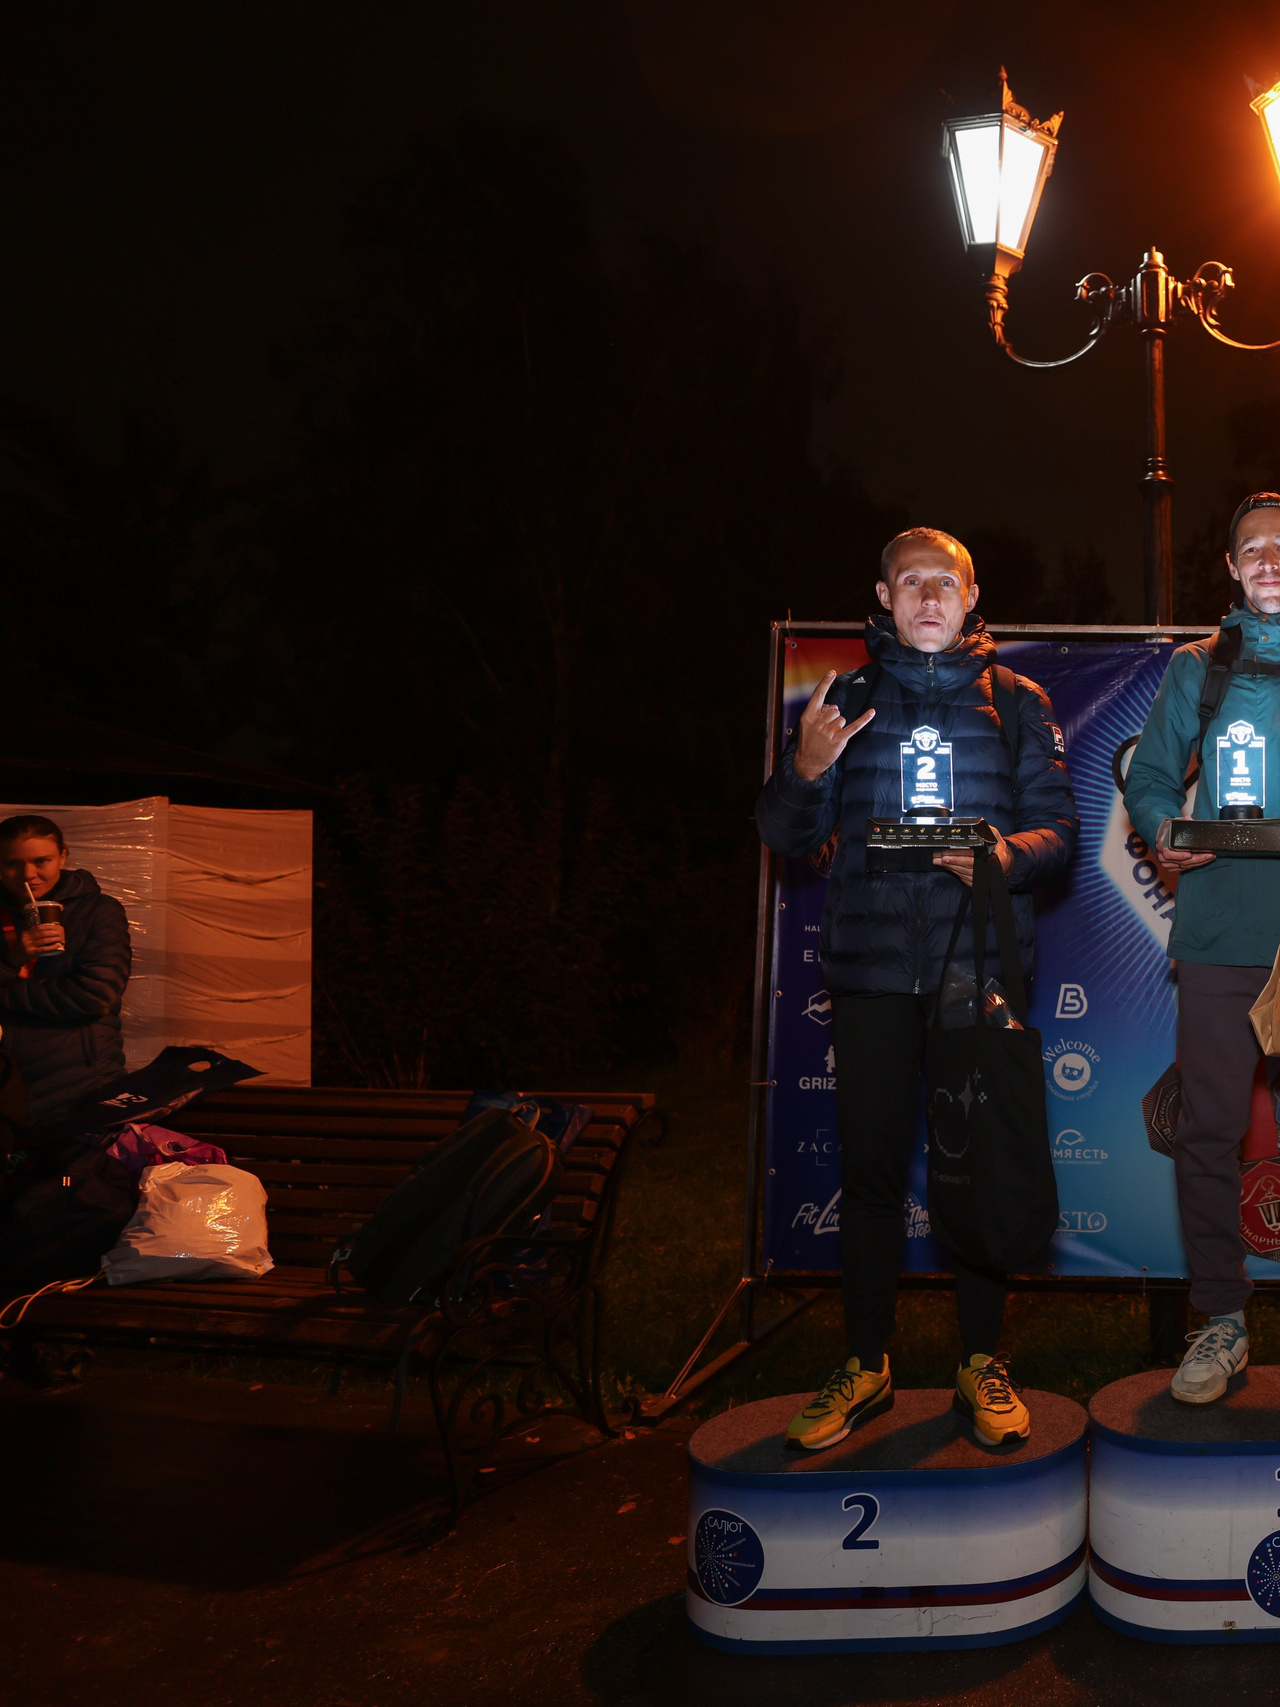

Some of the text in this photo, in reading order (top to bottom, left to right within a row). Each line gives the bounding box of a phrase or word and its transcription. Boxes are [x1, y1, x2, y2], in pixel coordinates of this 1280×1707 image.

[917, 756, 936, 780] 2
[1233, 750, 1249, 775] 1
[1042, 1038, 1101, 1064] Welcome
[1075, 1149, 1109, 1160] ЕСТЬ
[707, 1516, 743, 1535] САЛЮТ
[841, 1492, 880, 1550] 2
